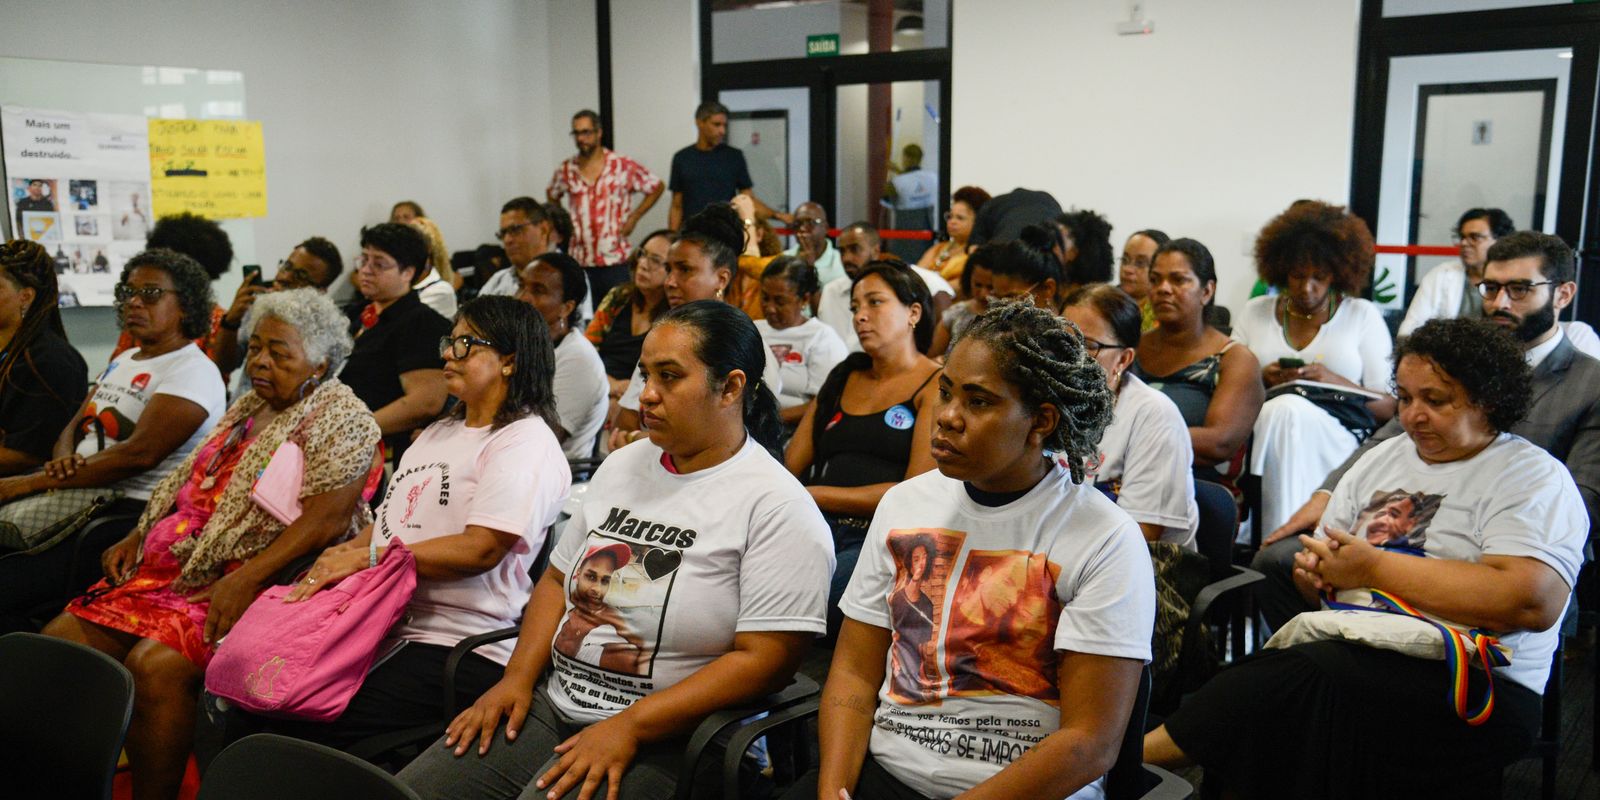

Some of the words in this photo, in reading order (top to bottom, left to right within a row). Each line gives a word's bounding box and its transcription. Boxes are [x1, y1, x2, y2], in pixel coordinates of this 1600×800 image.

[808, 39, 836, 53] SAÍDA
[25, 119, 51, 130] Mais
[53, 122, 71, 131] um
[34, 135, 67, 145] sonho
[386, 485, 396, 500] DE
[598, 506, 697, 549] Marcos
[639, 682, 654, 690] as
[569, 682, 586, 694] mas
[587, 688, 601, 698] eu
[602, 691, 632, 706] tenho
[938, 713, 970, 726] temos
[976, 715, 1001, 730] pela
[1007, 718, 1041, 728] nossa
[956, 733, 977, 760] SE
